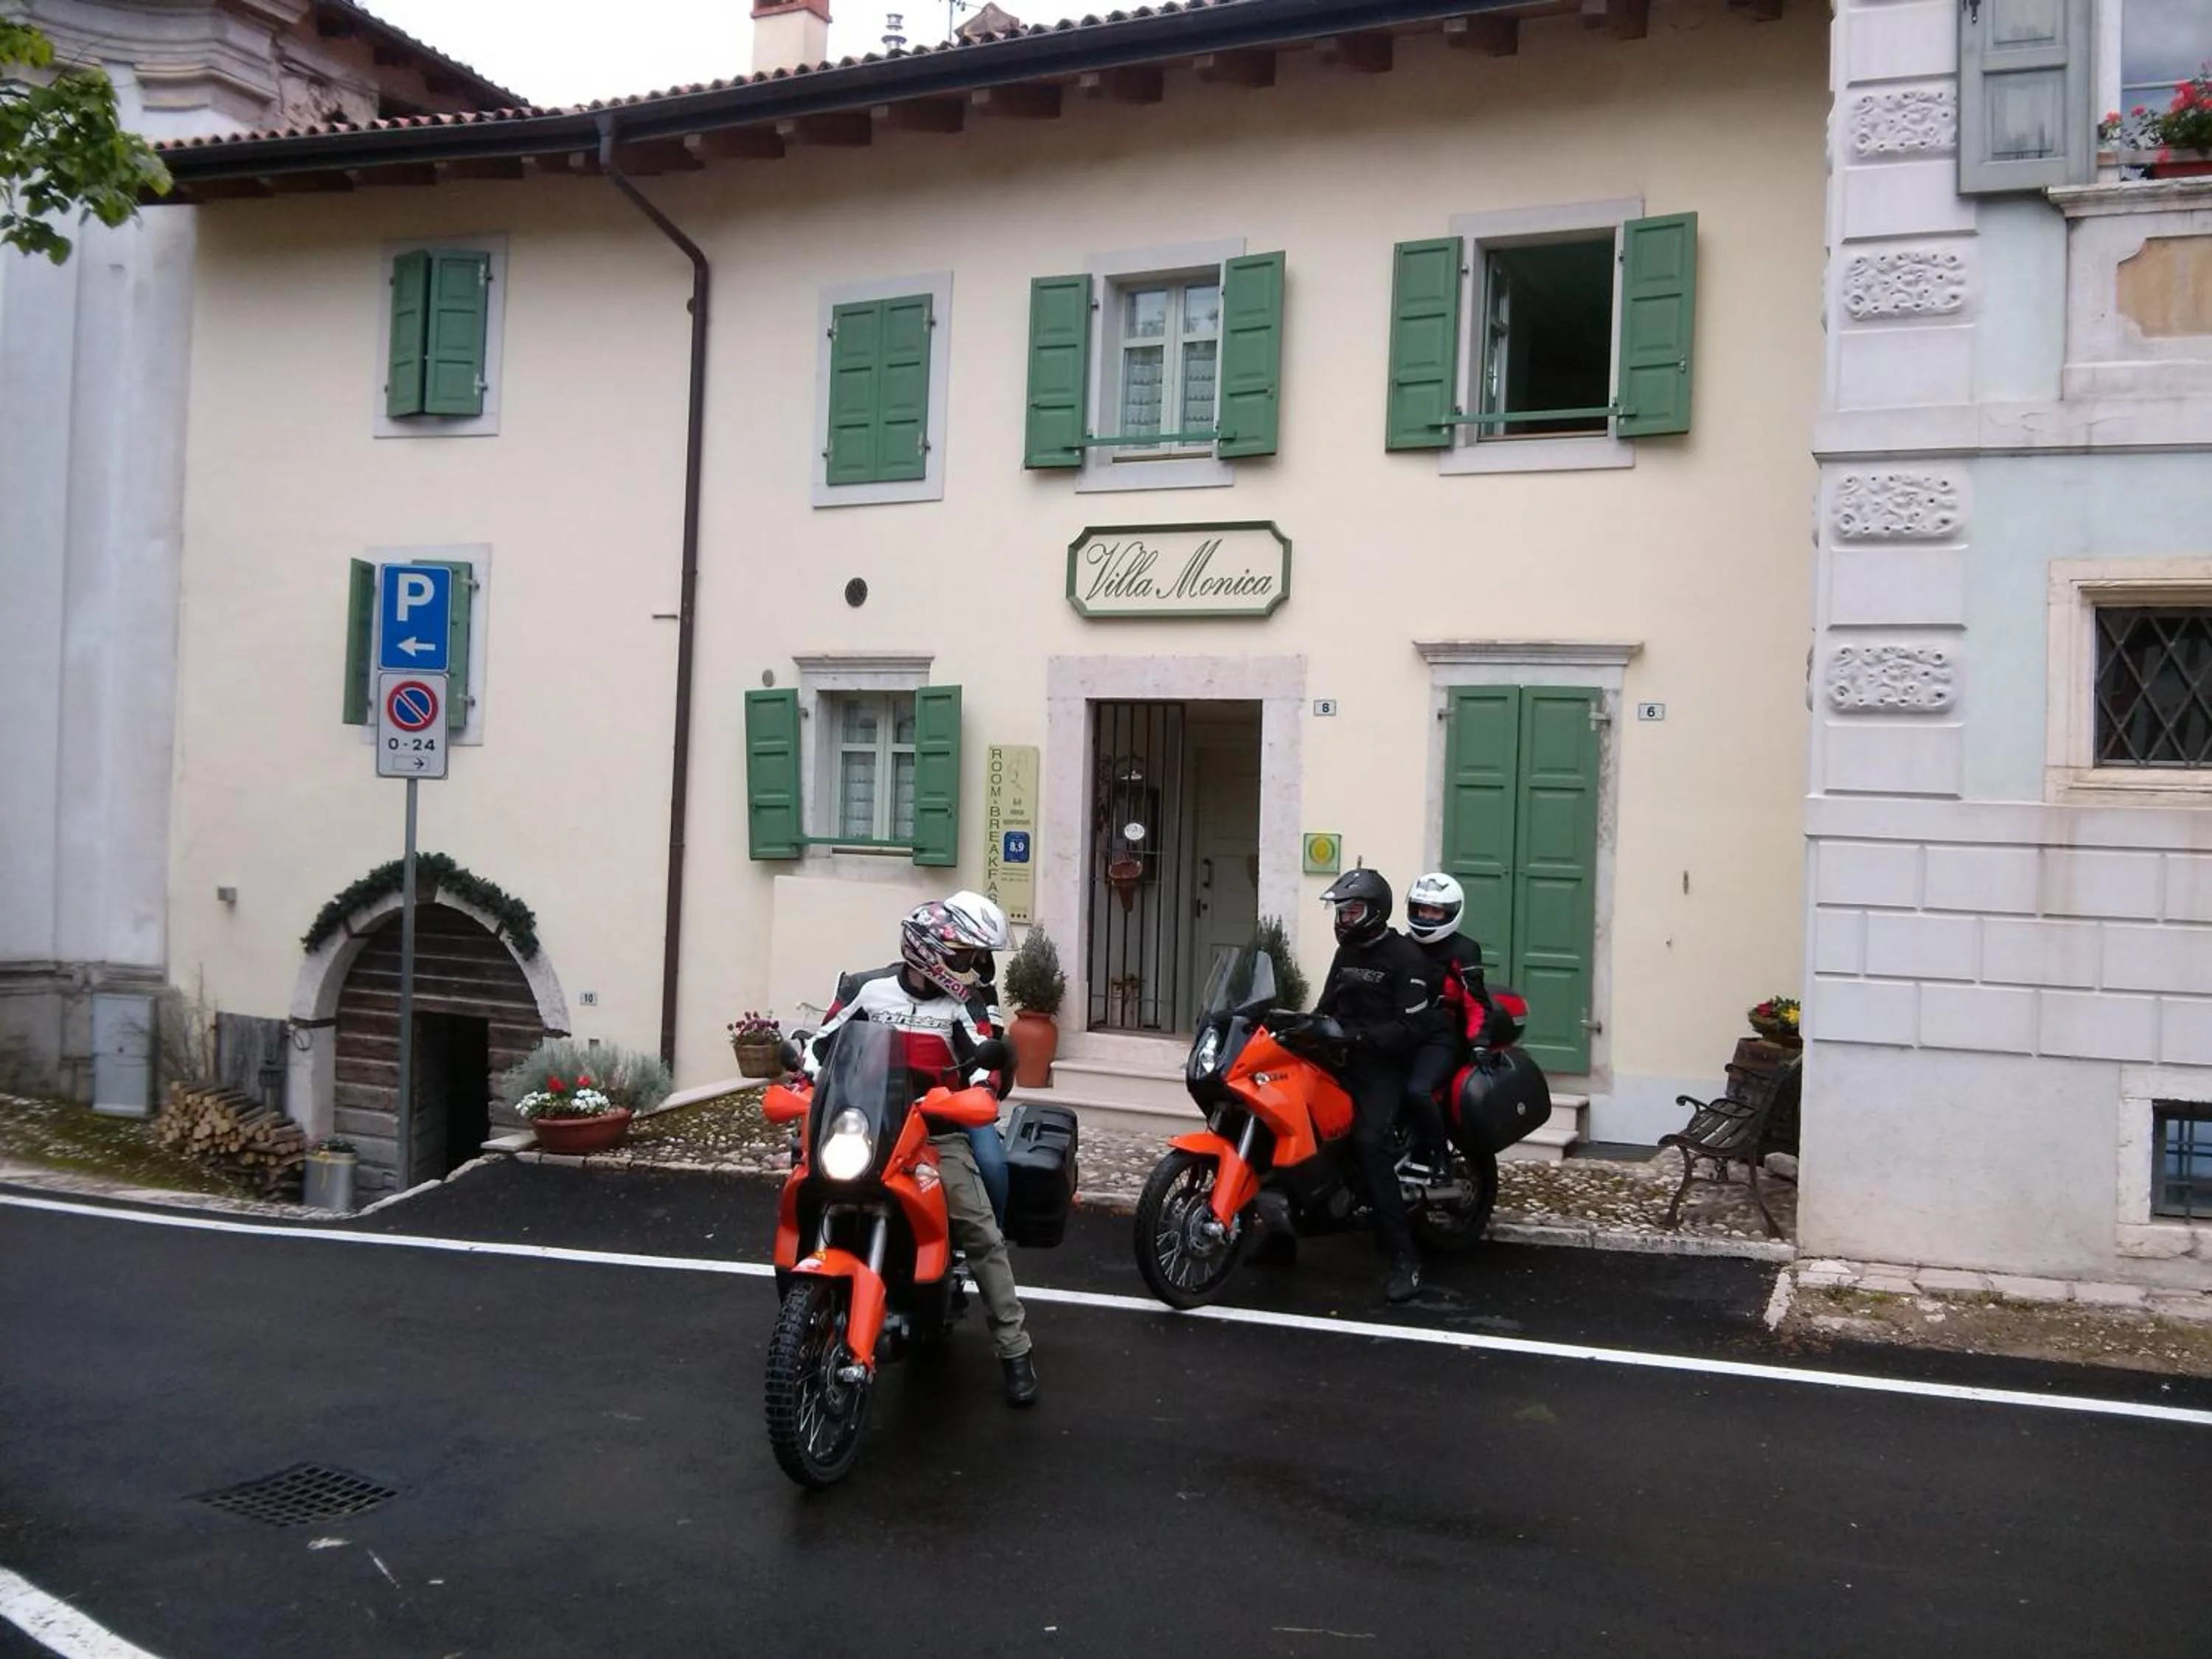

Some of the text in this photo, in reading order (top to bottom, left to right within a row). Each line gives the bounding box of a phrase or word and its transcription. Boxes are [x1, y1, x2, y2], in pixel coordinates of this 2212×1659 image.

[1085, 538, 1273, 601] Villa Monica
[397, 573, 434, 622] P
[1322, 703, 1330, 712] 8
[1646, 706, 1655, 717] 6
[412, 739, 436, 751] 24
[990, 748, 1002, 797] ROOM
[987, 807, 1001, 904] BREAKFAS
[584, 993, 594, 1004] 10
